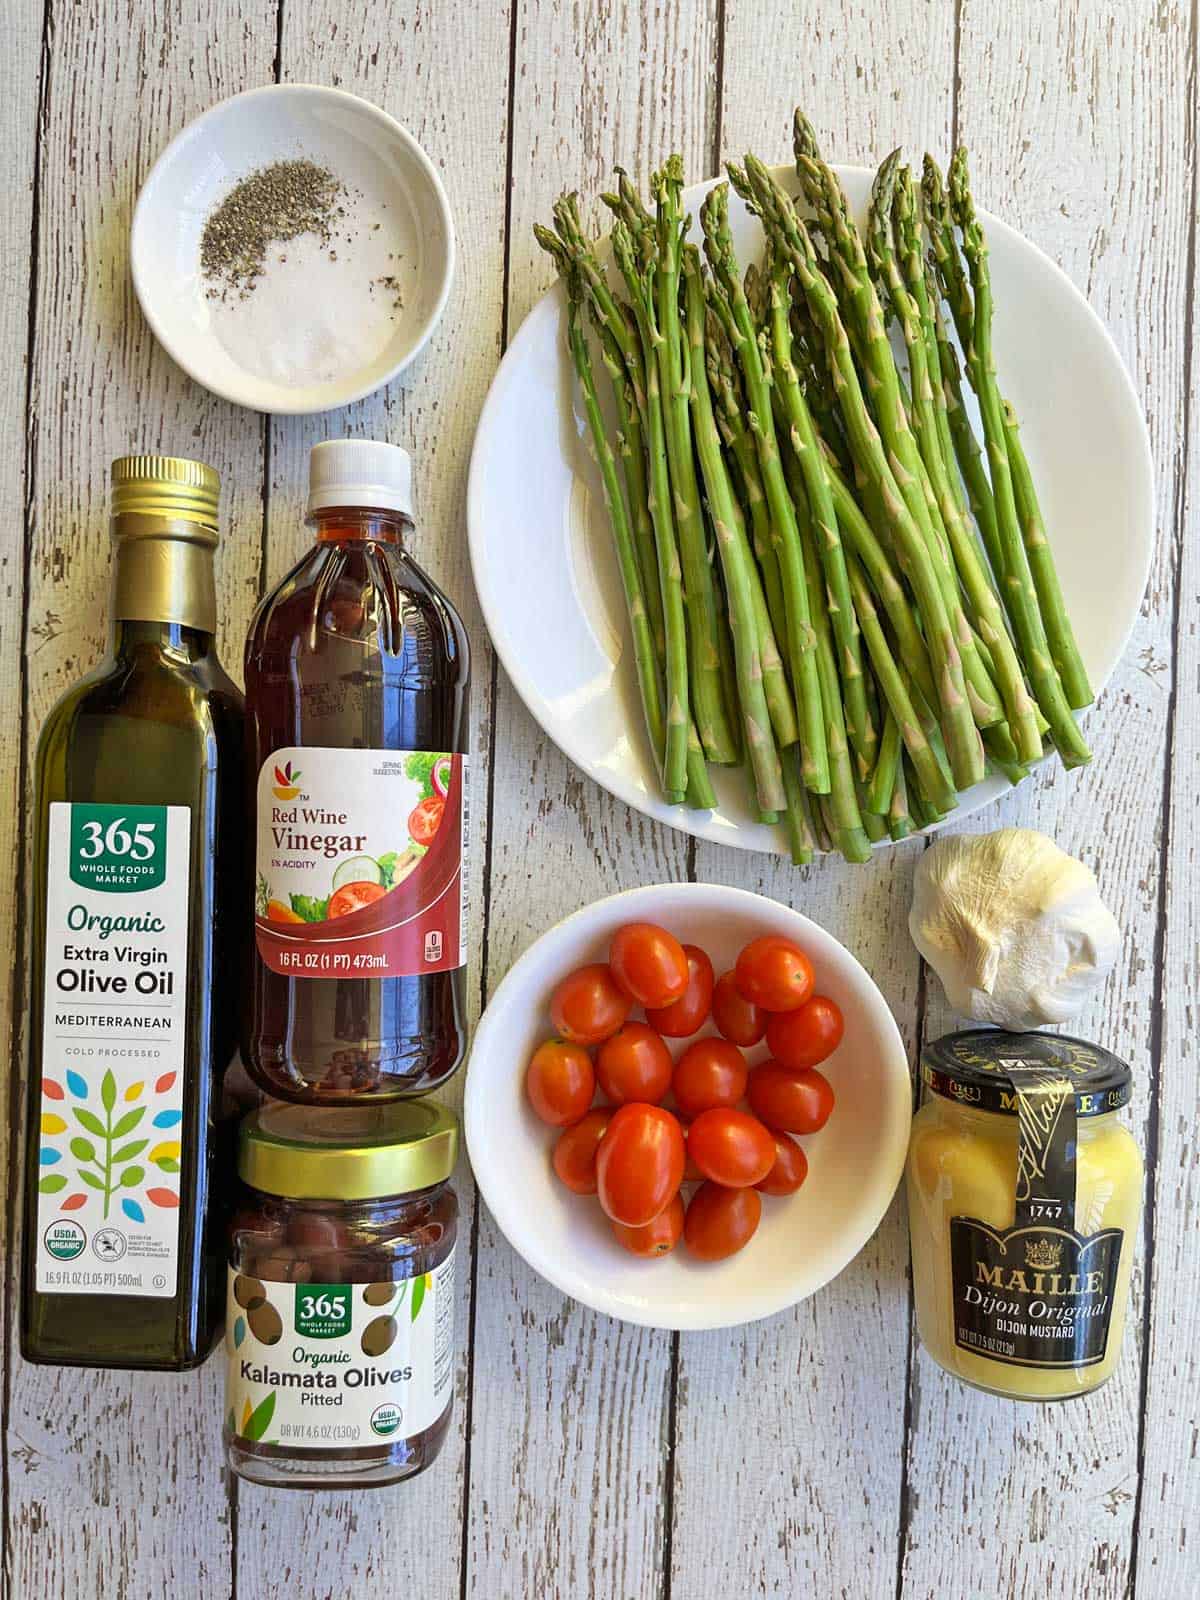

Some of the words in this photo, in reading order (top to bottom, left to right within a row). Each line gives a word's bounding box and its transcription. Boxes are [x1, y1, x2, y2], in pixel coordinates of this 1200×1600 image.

[272, 807, 297, 823] Red
[301, 808, 347, 825] Wine
[79, 817, 157, 861] 365
[272, 827, 367, 858] Vinegar
[79, 864, 116, 873] WHOLE
[120, 865, 155, 875] FOODS
[282, 860, 316, 869] ACIDITY
[96, 875, 139, 884] MARKET
[67, 904, 165, 940] Organic
[64, 945, 109, 962] Extra
[114, 946, 168, 966] Virgin
[279, 951, 290, 966] 16
[291, 952, 303, 967] FL
[304, 953, 319, 968] OZ
[320, 952, 330, 969] (1
[333, 953, 351, 970] PT)
[353, 954, 389, 968] 473mL
[56, 968, 127, 993] Olive
[134, 971, 173, 995] Oil
[55, 1015, 172, 1029] MEDITERRANEAN
[65, 1047, 95, 1057] COLD
[98, 1048, 160, 1058] PROCESSED
[1030, 1205, 1062, 1218] 1747
[54, 1229, 77, 1239] USDA
[50, 1240, 80, 1249] ORGANIC
[45, 1271, 62, 1284] 16.9
[62, 1271, 71, 1284] FL
[72, 1272, 82, 1285] OZ
[104, 1273, 117, 1287] PT)
[976, 1261, 1104, 1295] MAILLE
[300, 1293, 346, 1319] 365
[964, 1285, 1021, 1315] Dijon
[1028, 1295, 1108, 1326] Original
[996, 1318, 1027, 1336] DIJON
[1029, 1324, 1074, 1339] MUSTARD
[292, 1346, 352, 1369] Organic
[240, 1360, 337, 1388] Kalamata
[343, 1365, 412, 1388] Olives
[301, 1392, 343, 1406] Pitted
[280, 1423, 291, 1437] DR
[292, 1424, 304, 1438] WT
[307, 1424, 319, 1439] 4.6
[321, 1424, 331, 1439] OZ
[333, 1424, 360, 1441] (130g)
